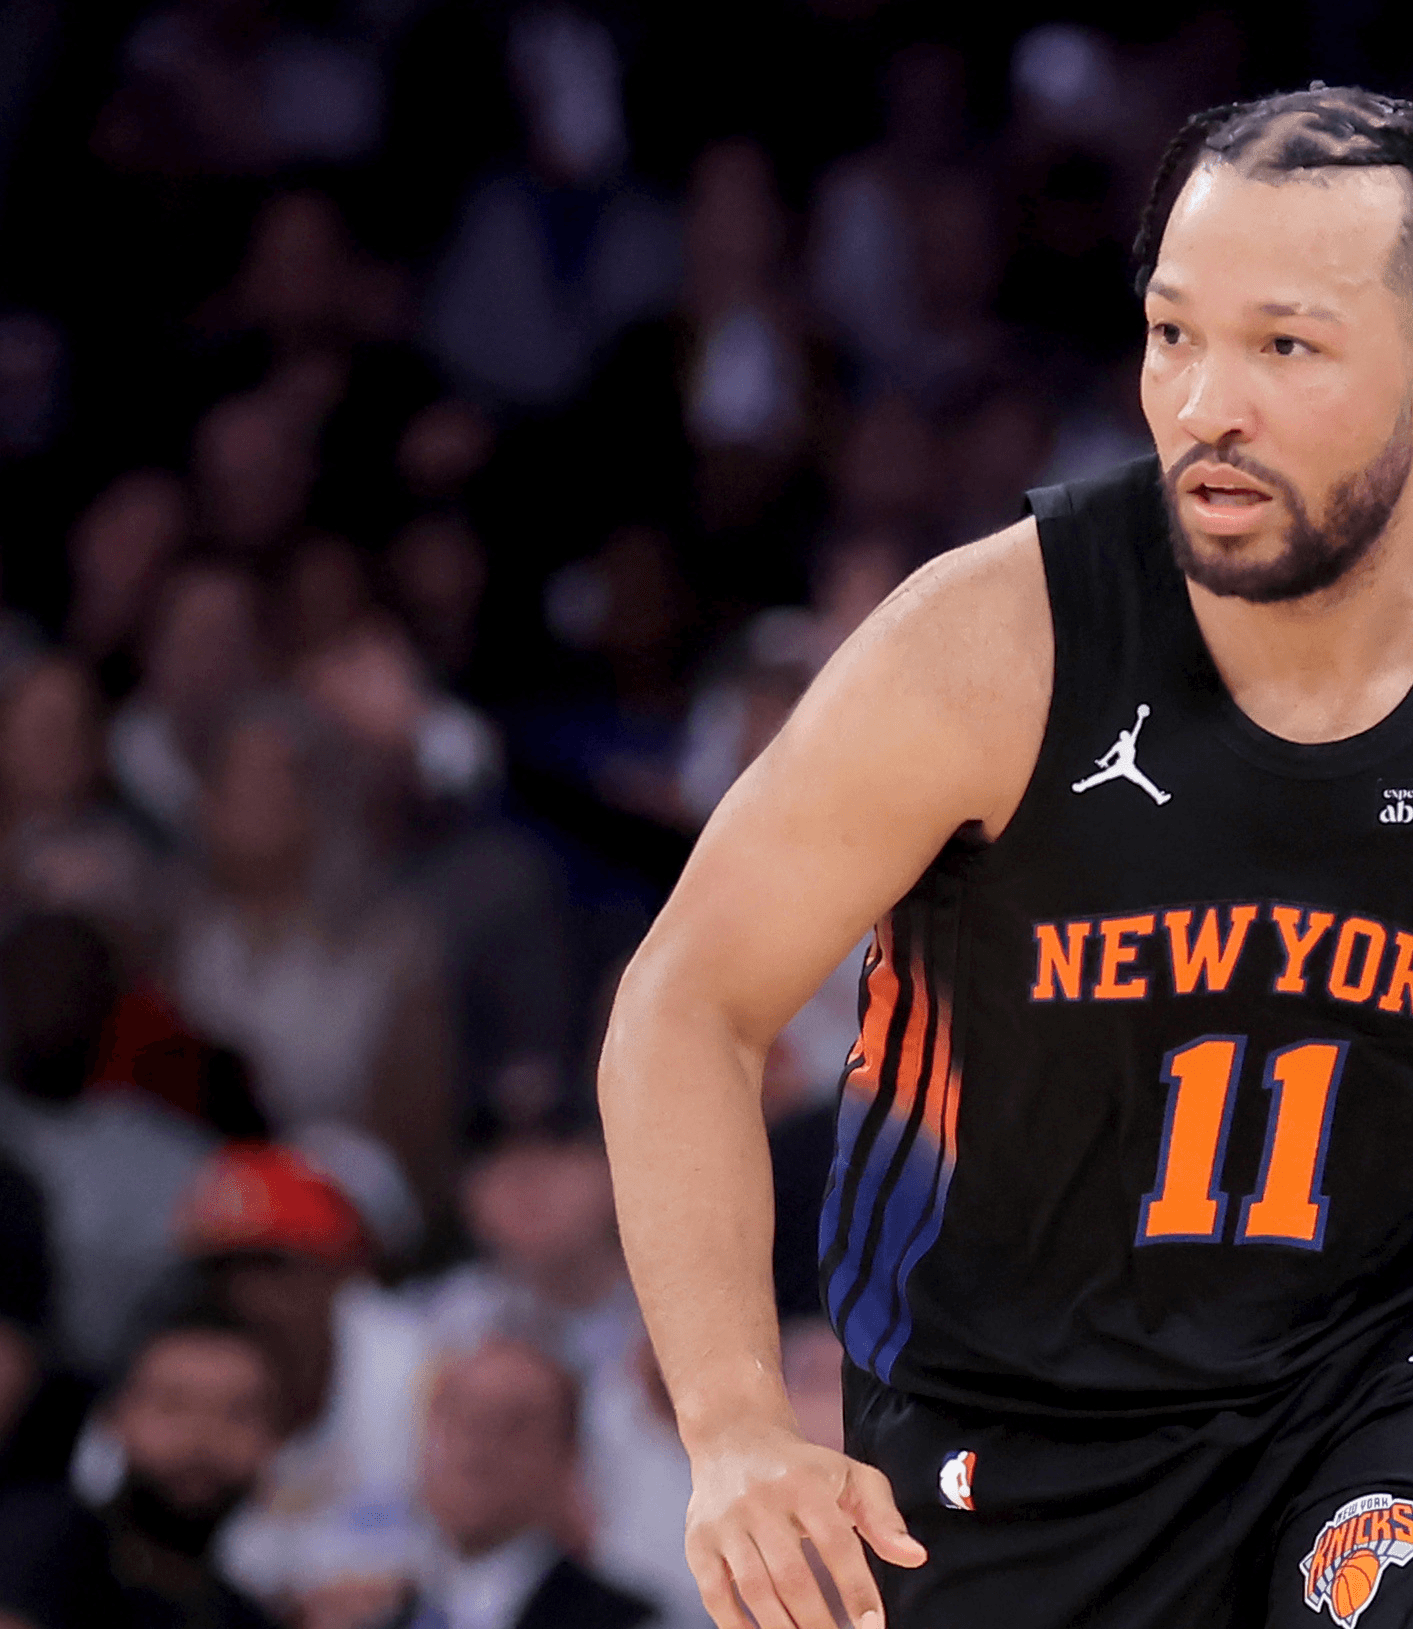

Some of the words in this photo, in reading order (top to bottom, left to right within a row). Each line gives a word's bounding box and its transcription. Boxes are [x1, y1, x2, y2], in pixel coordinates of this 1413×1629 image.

[1031, 903, 1260, 1001] NEW
[1134, 1034, 1350, 1252] 11
[1360, 1497, 1389, 1510] YORK
